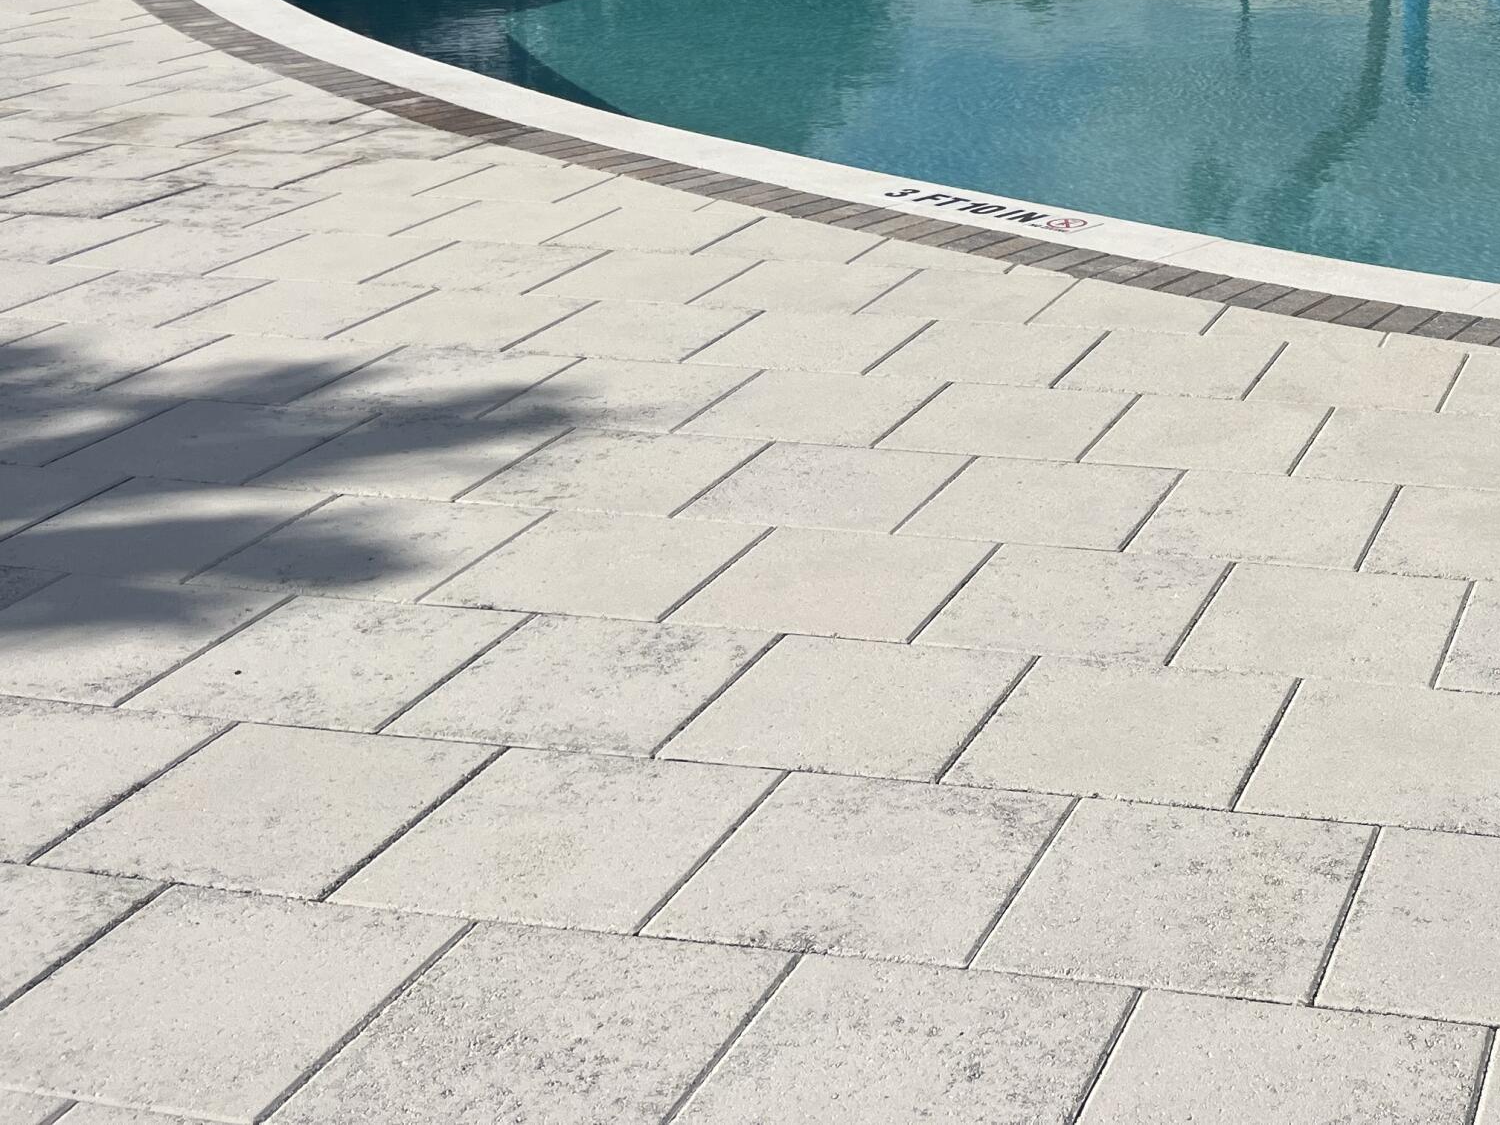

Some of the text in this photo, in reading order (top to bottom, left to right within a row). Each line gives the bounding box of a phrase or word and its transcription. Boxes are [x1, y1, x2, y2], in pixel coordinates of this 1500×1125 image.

[885, 188, 1051, 223] 3 FT 10 IN
